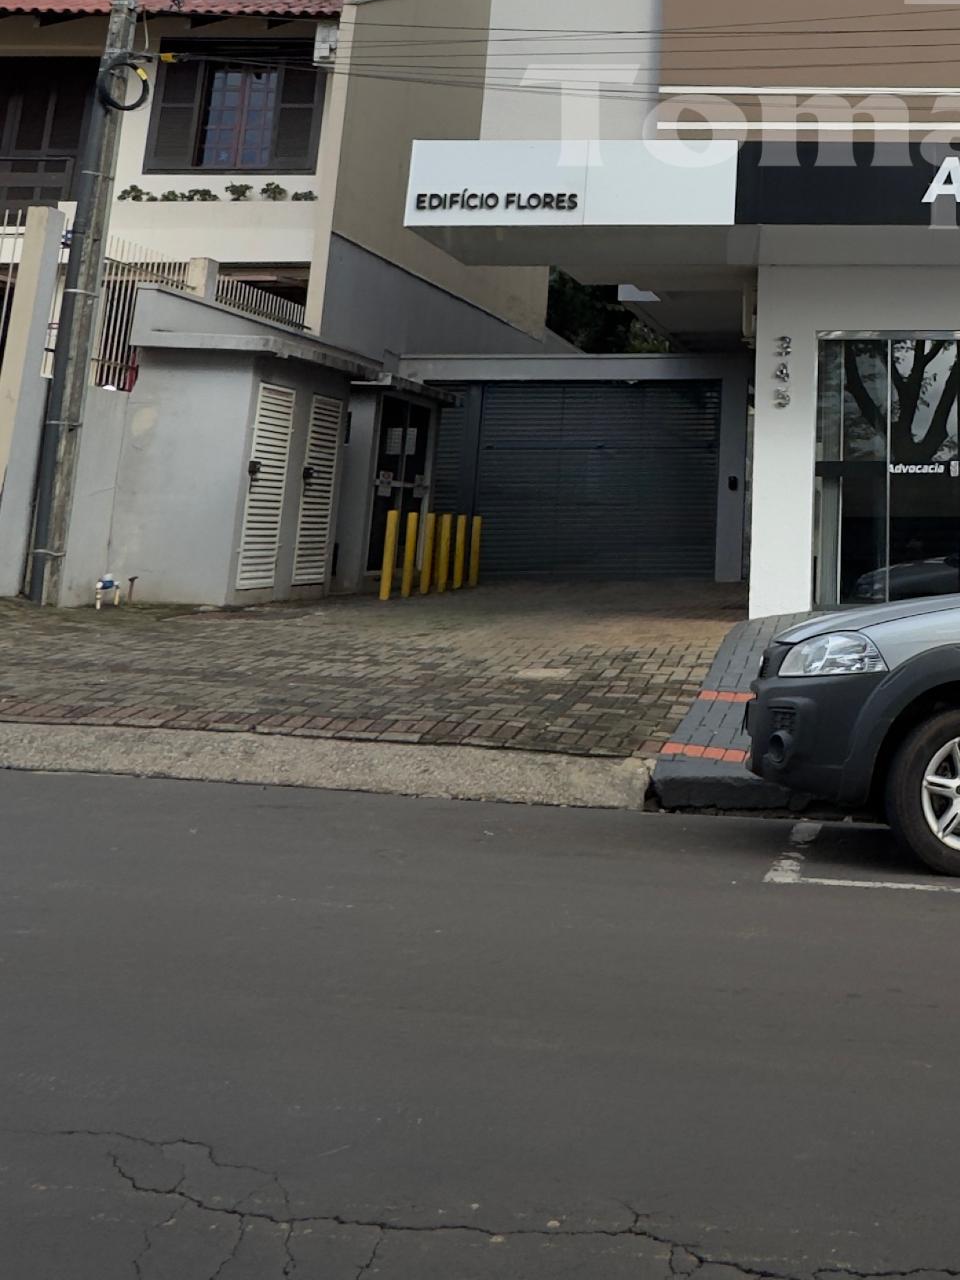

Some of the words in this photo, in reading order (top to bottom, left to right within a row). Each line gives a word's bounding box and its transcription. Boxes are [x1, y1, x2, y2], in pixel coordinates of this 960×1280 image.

[416, 188, 499, 210] EDIFÍCIO
[505, 193, 578, 210] FLORES
[888, 463, 945, 474] Advocacia
